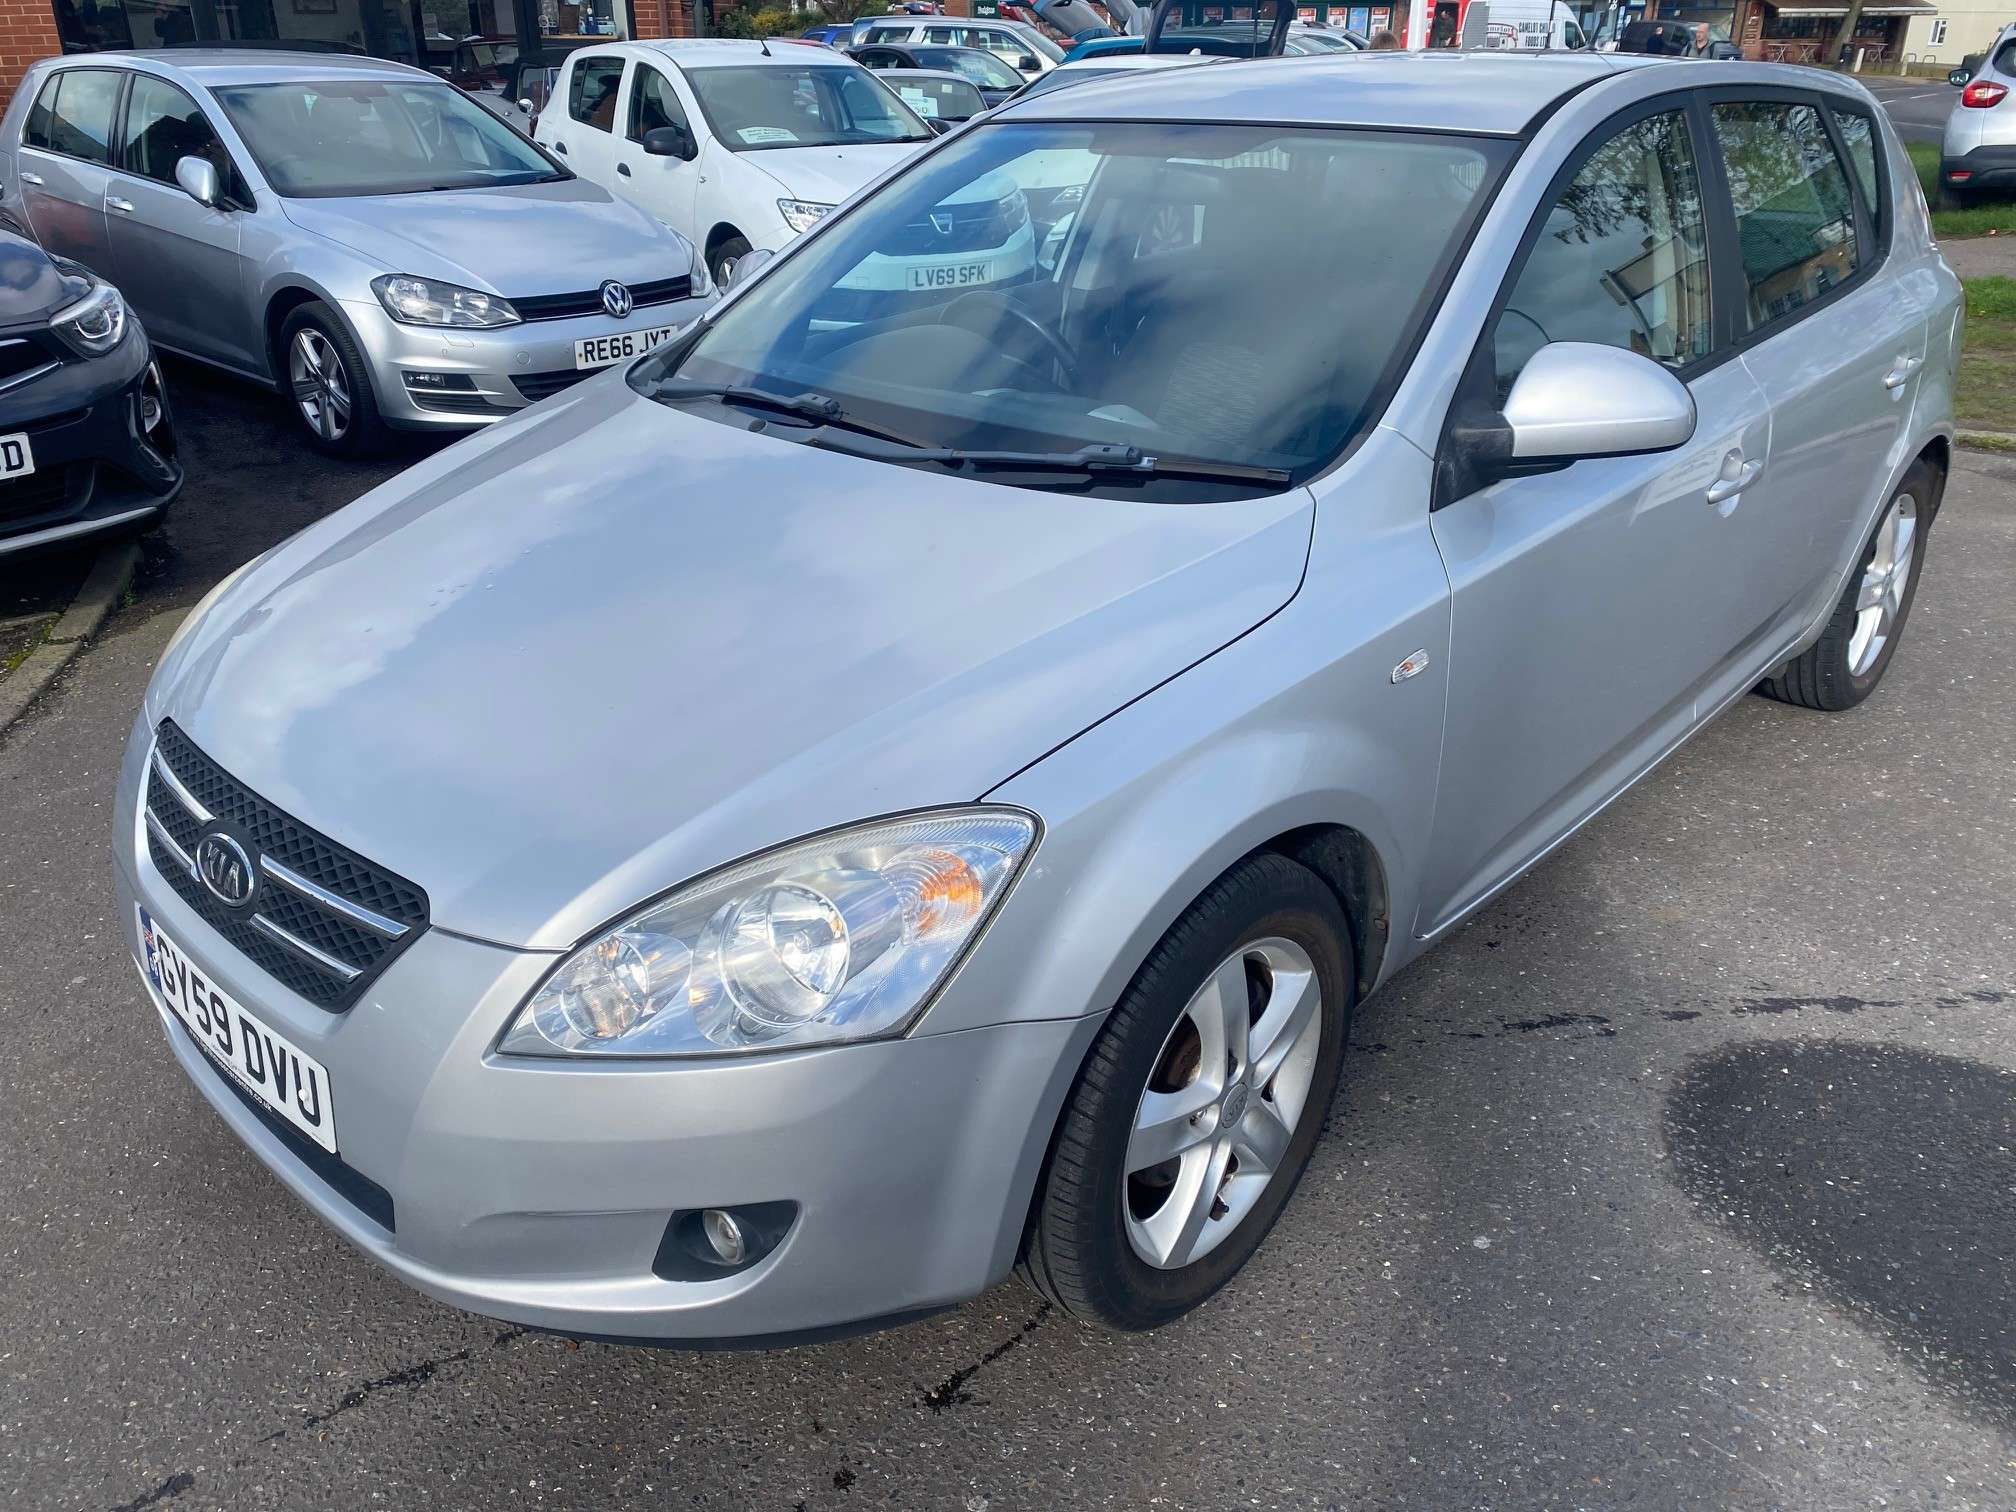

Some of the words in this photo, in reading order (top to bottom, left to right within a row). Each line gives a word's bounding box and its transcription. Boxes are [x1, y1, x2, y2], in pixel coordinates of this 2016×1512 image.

[1519, 22, 1538, 33] CAMELOT
[1525, 35, 1539, 47] FOODS
[914, 268, 955, 287] LV69
[959, 264, 985, 283] SFK
[583, 335, 633, 362] RE66
[156, 933, 234, 1057] GY59
[238, 1013, 321, 1128] DVU
